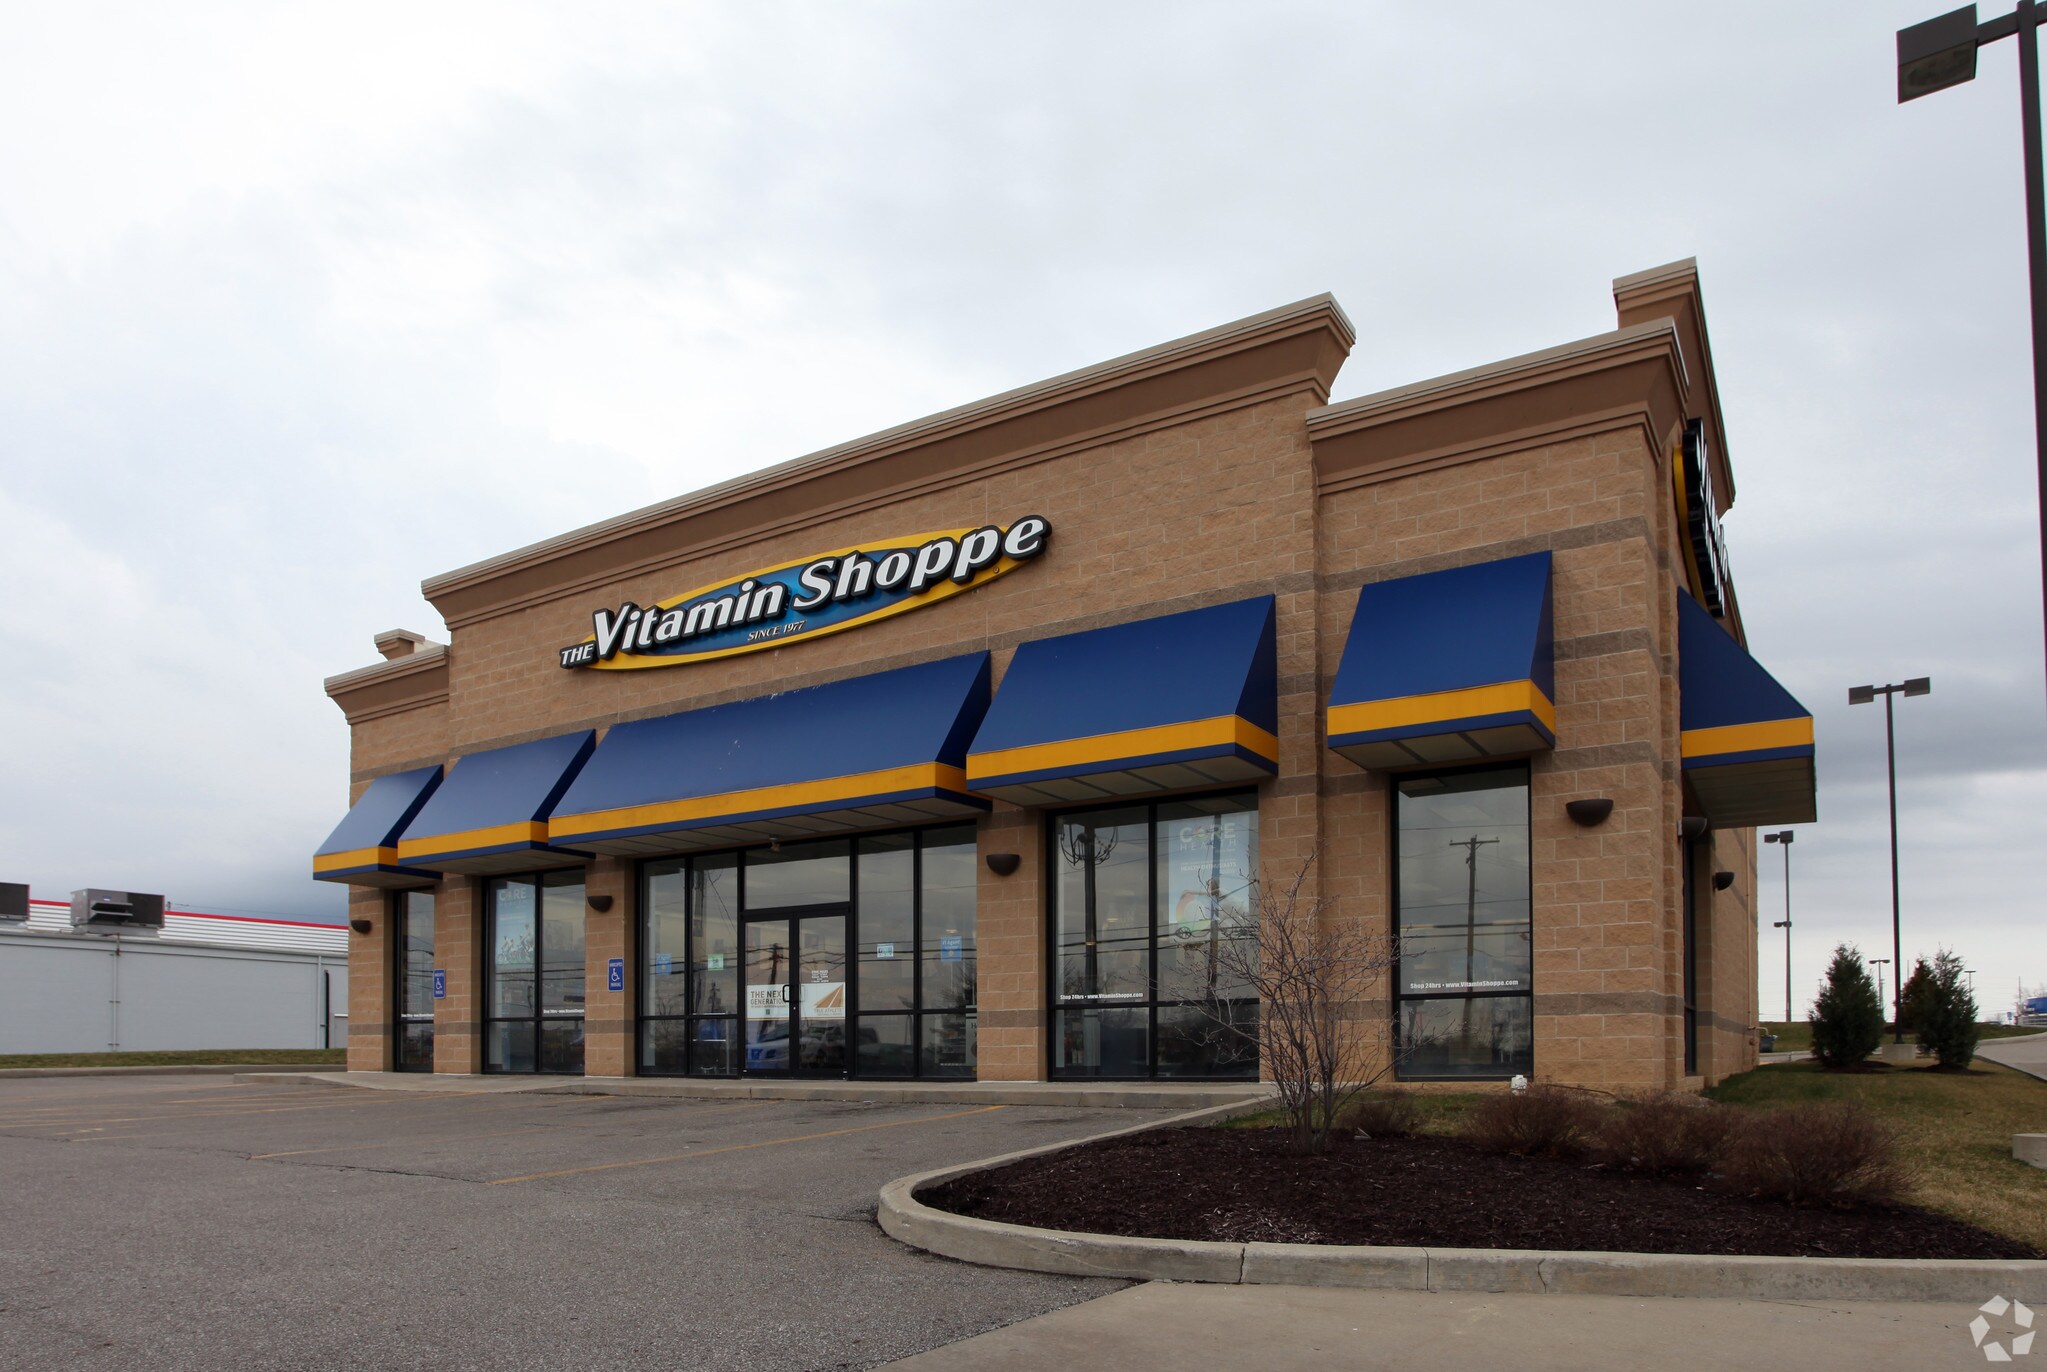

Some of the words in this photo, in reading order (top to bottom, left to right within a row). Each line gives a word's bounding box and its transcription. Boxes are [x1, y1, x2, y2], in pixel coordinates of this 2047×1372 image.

[561, 642, 595, 666] THE
[594, 578, 785, 657] Vitamin
[794, 517, 1047, 609] Shoppe
[747, 625, 781, 641] SINCE
[783, 619, 808, 633] 1977
[1445, 980, 1519, 988] www.VitaminShoppe.com
